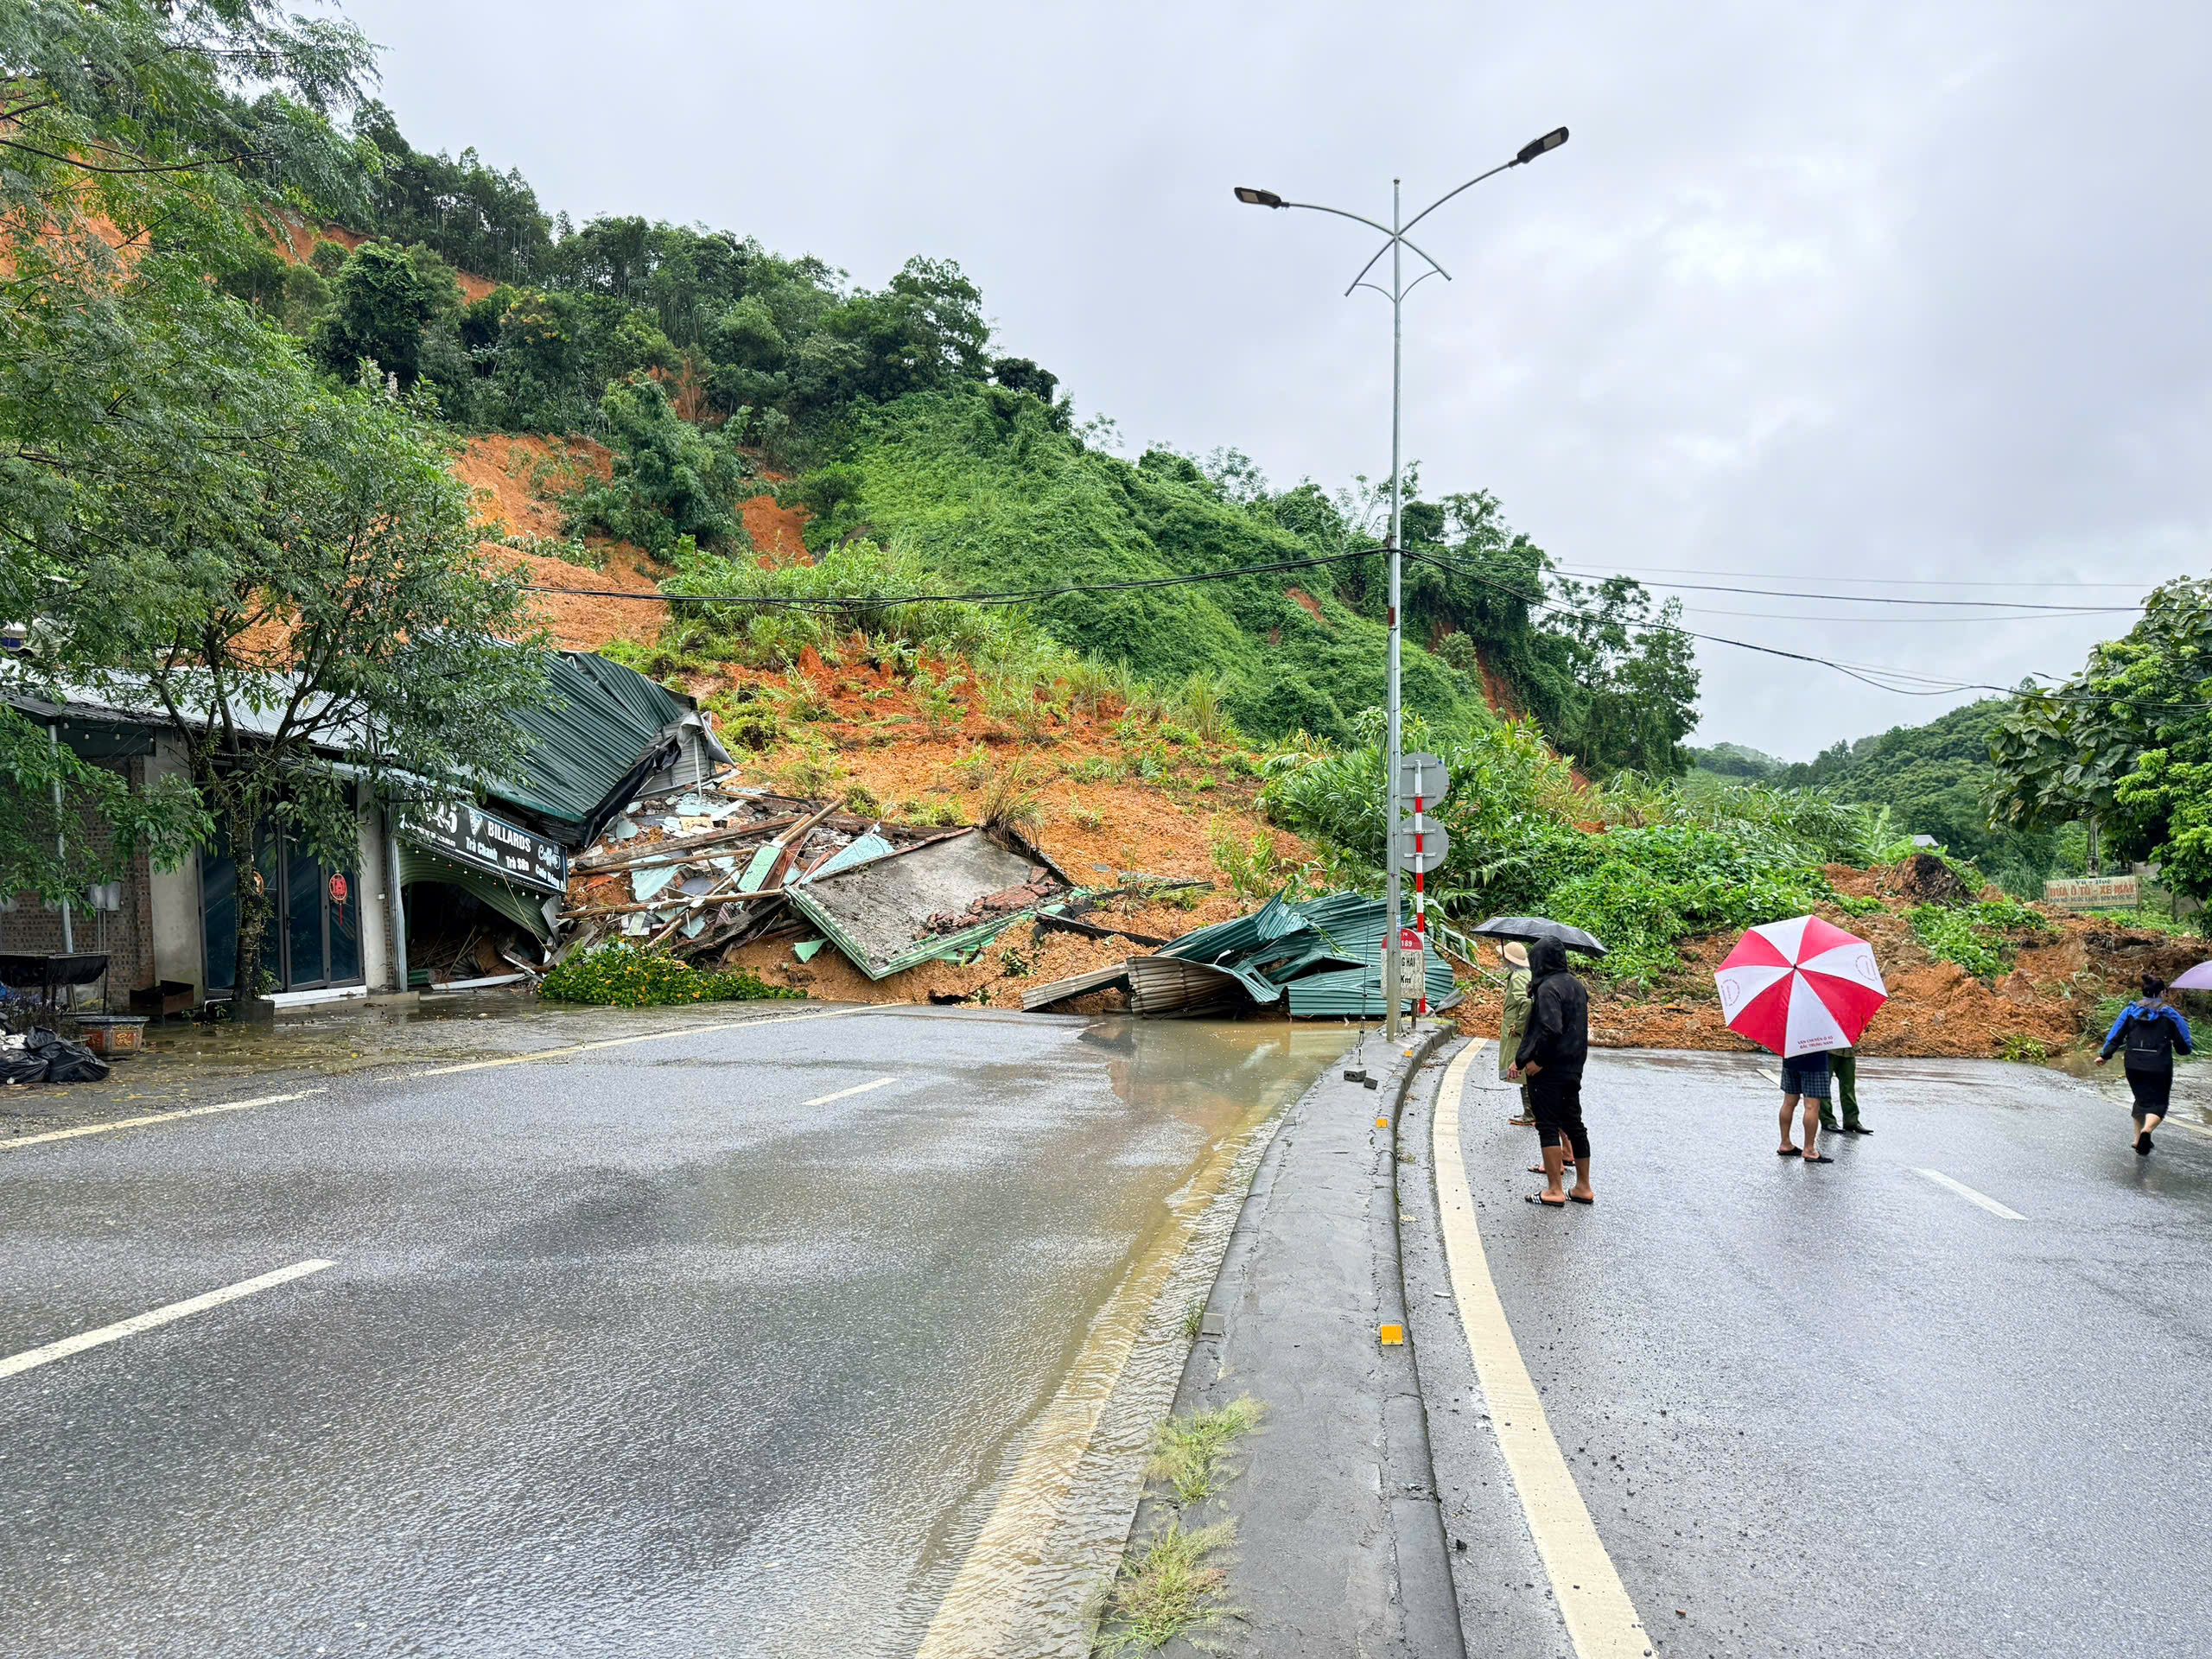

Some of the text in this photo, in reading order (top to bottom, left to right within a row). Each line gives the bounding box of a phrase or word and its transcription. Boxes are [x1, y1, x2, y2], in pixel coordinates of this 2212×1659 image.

[487, 820, 531, 853] BILLARDS
[465, 836, 499, 861] Trà Chanh
[505, 855, 517, 869] Trà
[2101, 885, 2112, 895] XE
[1401, 975, 1411, 983] Km
